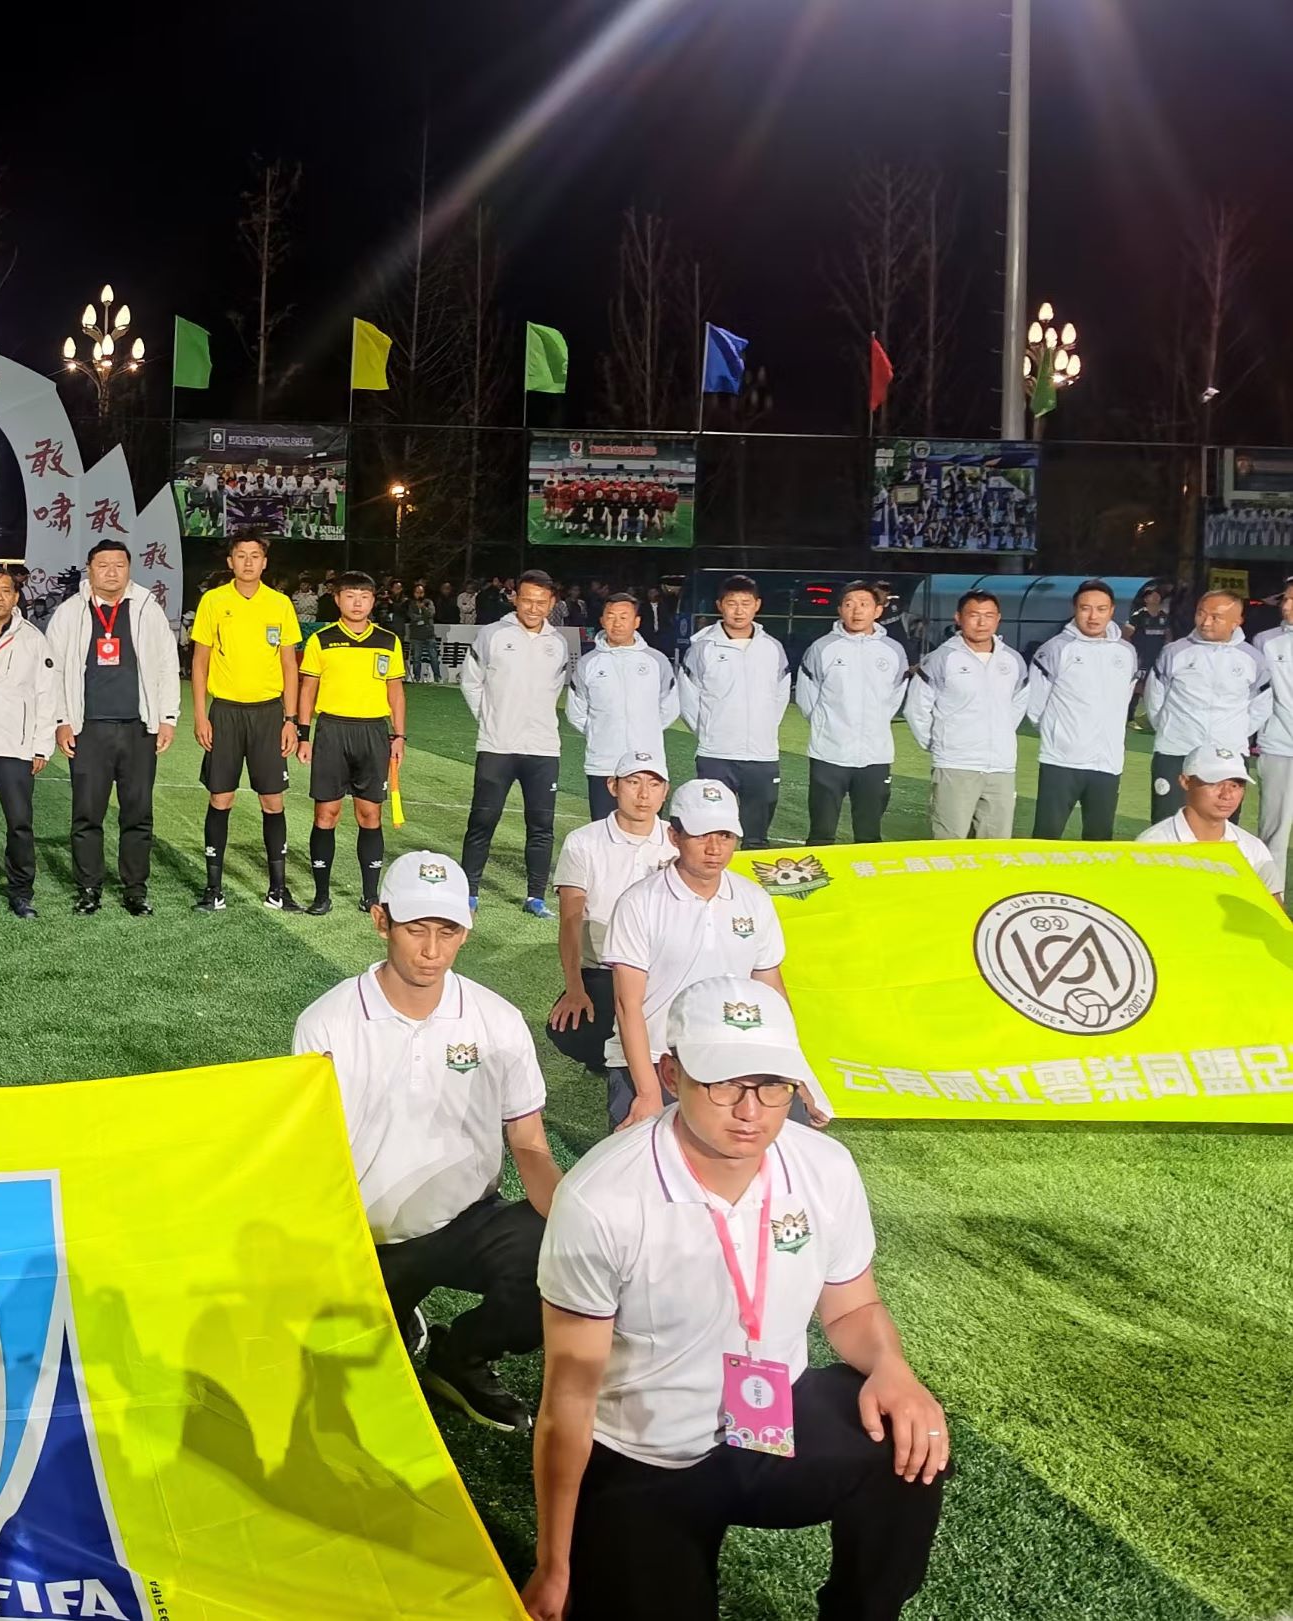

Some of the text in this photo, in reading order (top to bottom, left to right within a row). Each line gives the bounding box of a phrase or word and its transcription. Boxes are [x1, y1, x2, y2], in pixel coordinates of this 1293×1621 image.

[1008, 896, 1070, 910] UNITED
[1025, 1003, 1057, 1025] SINCE
[1122, 993, 1146, 1019] 2007
[149, 1580, 165, 1605] FIFA
